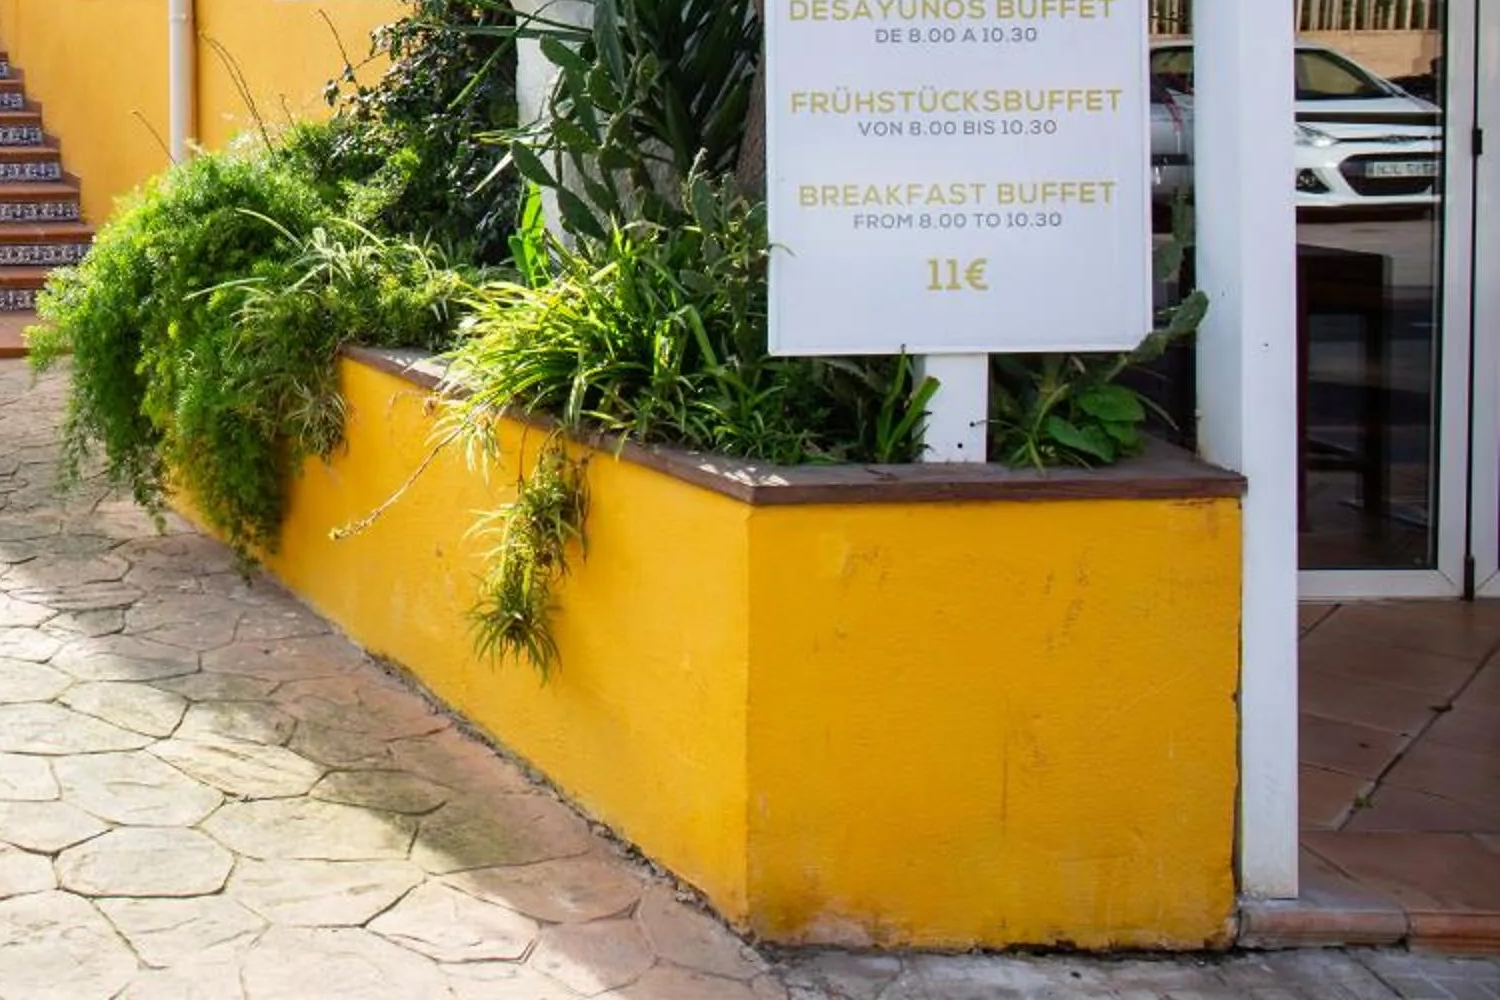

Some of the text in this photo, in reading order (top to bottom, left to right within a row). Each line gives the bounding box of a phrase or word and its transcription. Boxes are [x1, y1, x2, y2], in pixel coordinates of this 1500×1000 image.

[875, 26, 1038, 44] DE 8.00 A 10.30
[791, 85, 1124, 114] FRÜHSTÜCKSBUFFET
[857, 119, 1058, 137] VON 8.00 BIS 10.30
[799, 181, 1117, 207] BREAKFAST BUFFET
[853, 211, 1063, 230] FROM 8.00 TO 10.30
[927, 257, 989, 292] 11€
